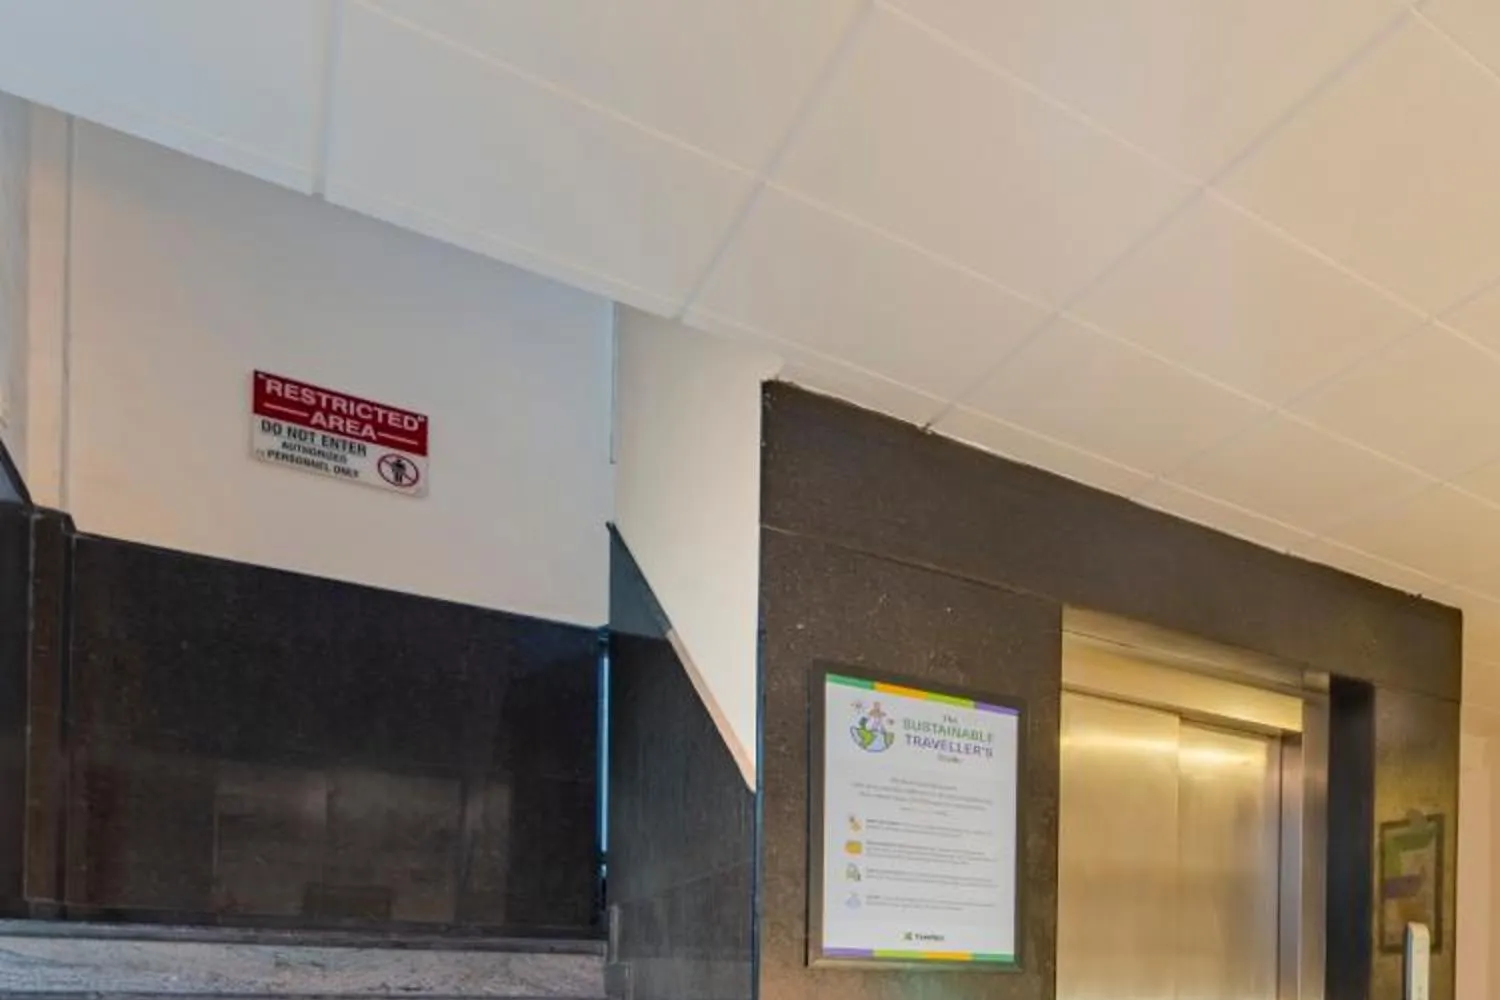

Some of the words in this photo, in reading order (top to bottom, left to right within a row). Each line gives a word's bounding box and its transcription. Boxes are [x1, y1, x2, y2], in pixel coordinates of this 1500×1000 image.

[262, 419, 282, 435] DO
[287, 426, 315, 443] NOT
[322, 434, 366, 457] ENTER
[310, 411, 377, 441] AREA
[903, 717, 993, 743] SUSTAINABLE
